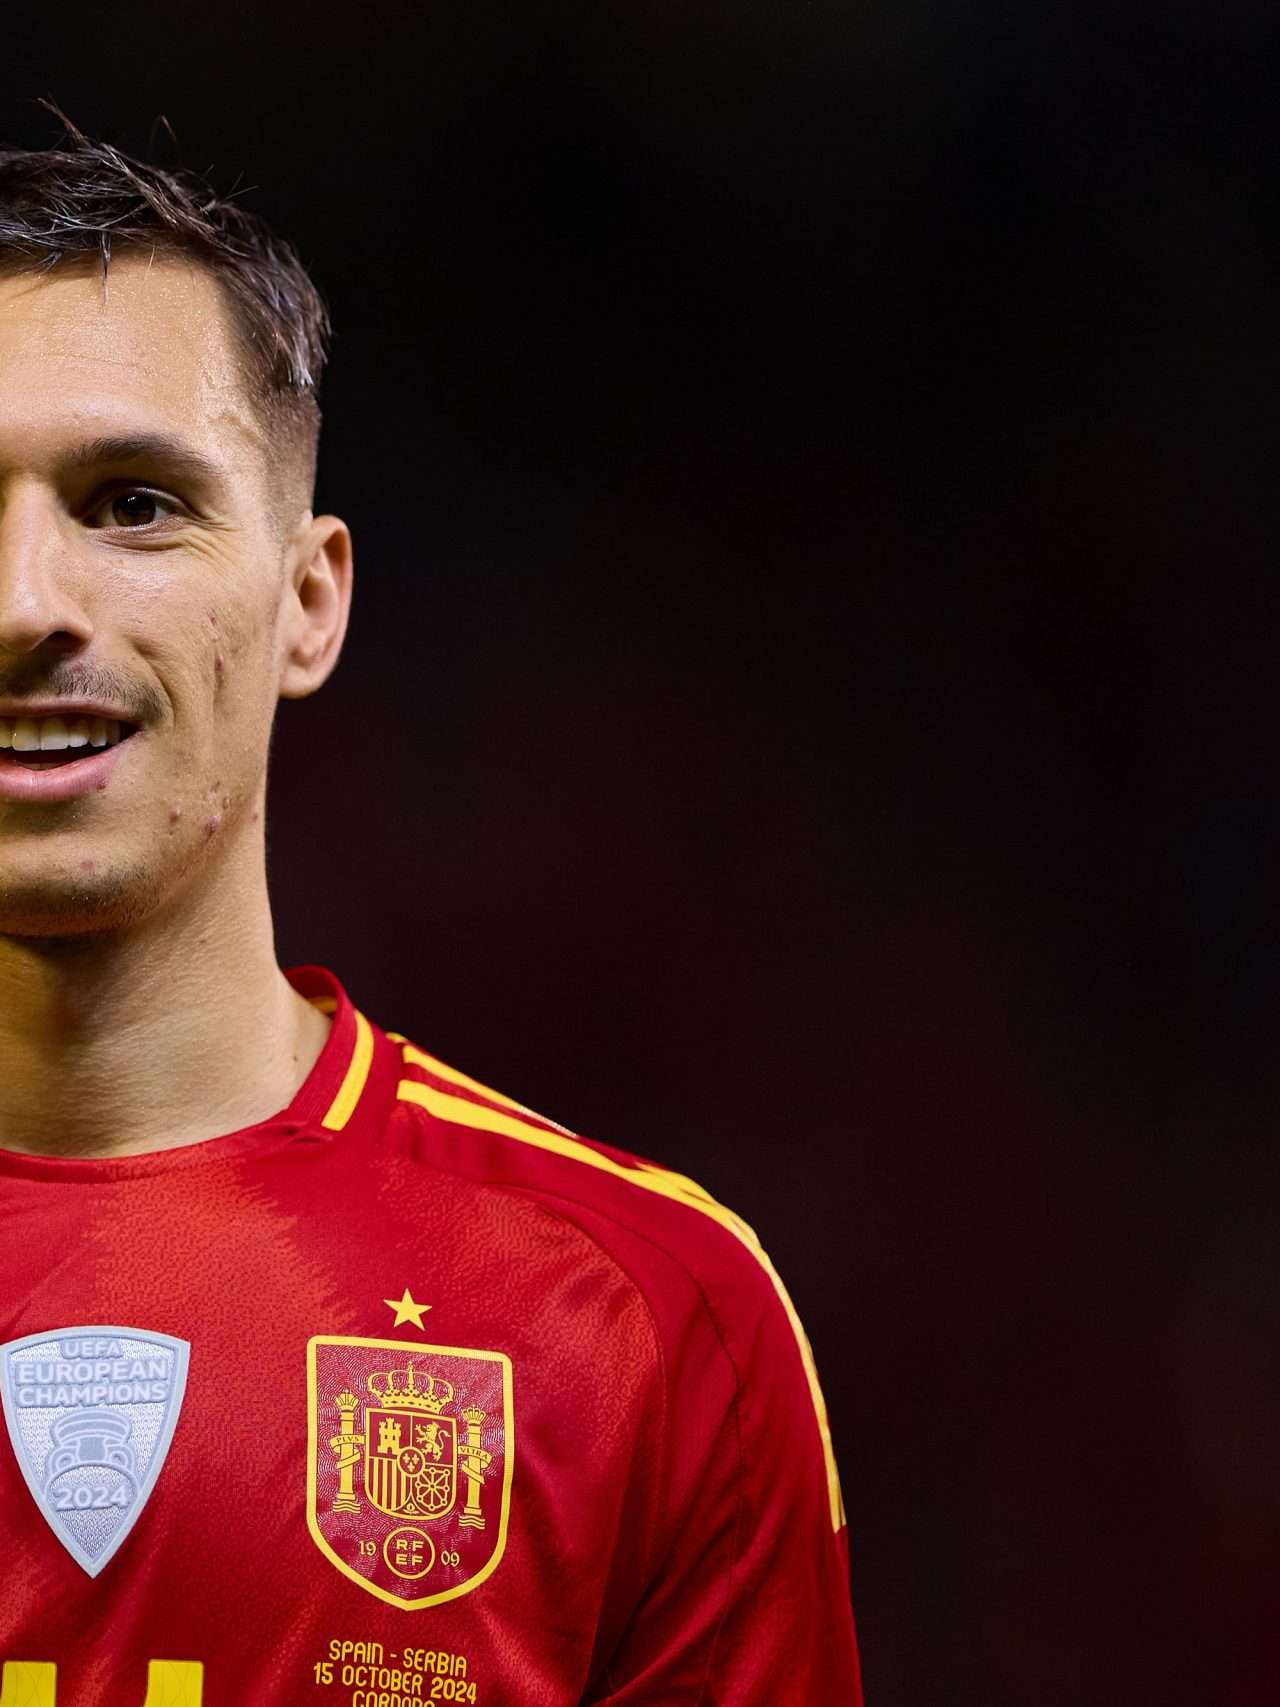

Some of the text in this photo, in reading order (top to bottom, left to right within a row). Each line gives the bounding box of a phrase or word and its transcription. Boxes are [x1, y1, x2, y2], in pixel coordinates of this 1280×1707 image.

[63, 1339, 122, 1357] UEFA
[19, 1360, 168, 1384] EUROPEAN
[19, 1383, 168, 1407] CHAMPIONS
[56, 1485, 129, 1508] 2024
[360, 1540, 377, 1556] 19
[440, 1550, 460, 1567] 09
[329, 1639, 384, 1665] SPAIN
[402, 1647, 467, 1678] SERBIA
[313, 1662, 477, 1705] 15 OCTOBER 2024
